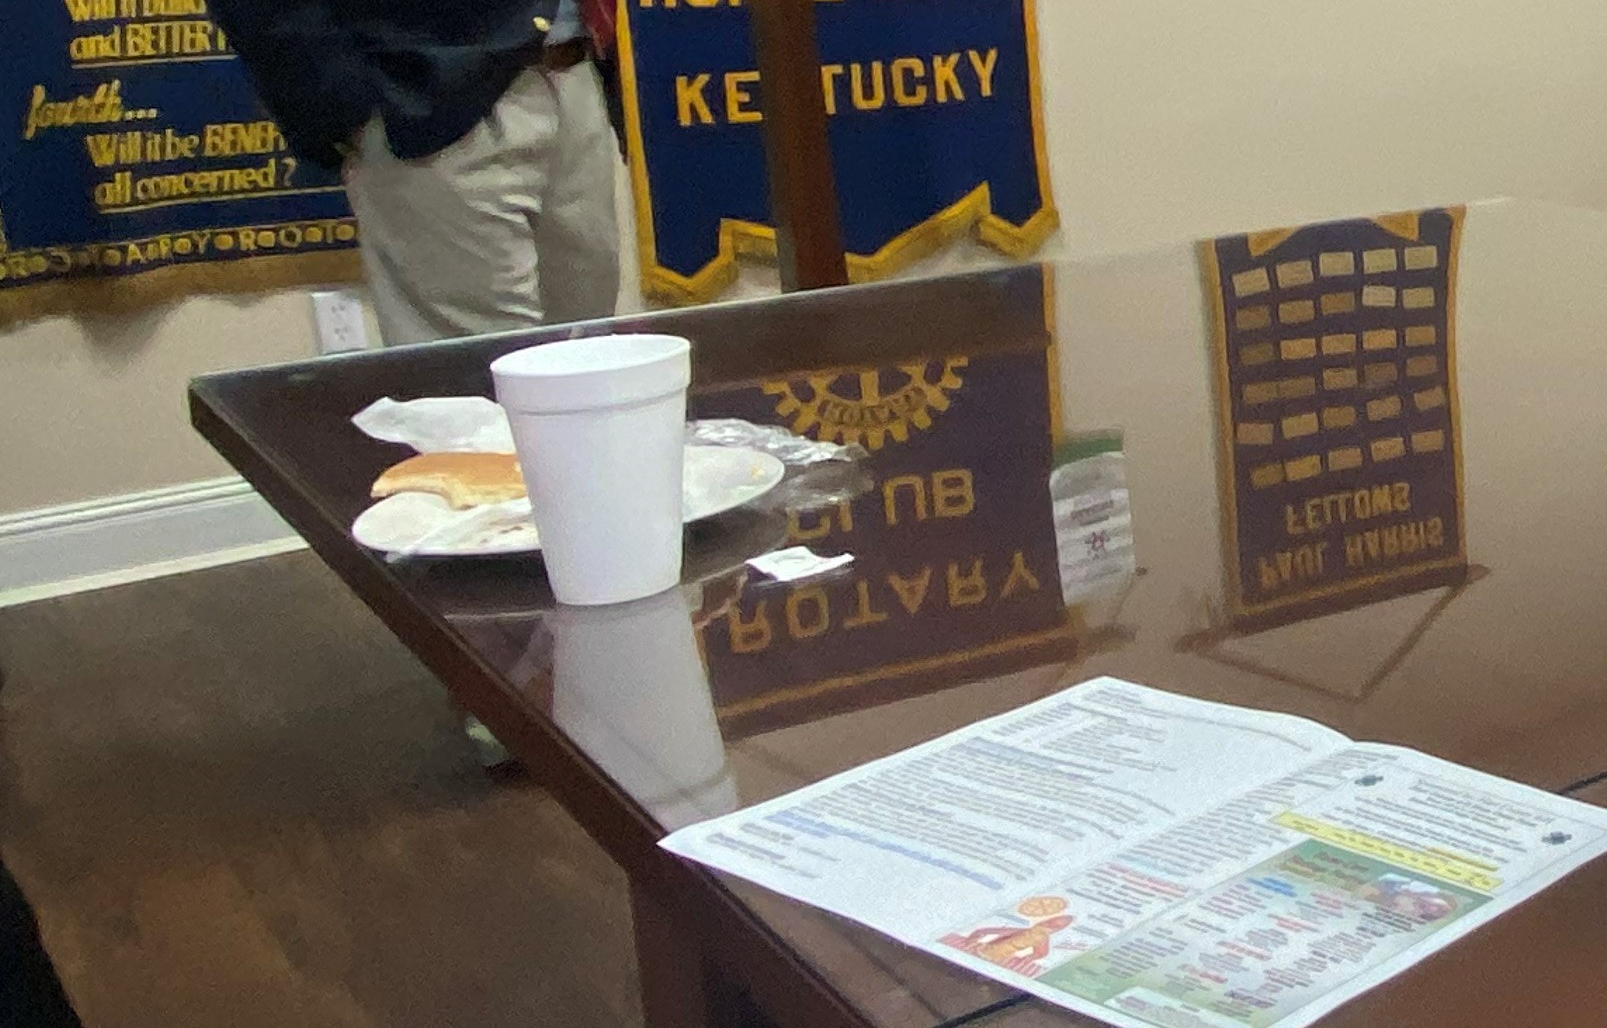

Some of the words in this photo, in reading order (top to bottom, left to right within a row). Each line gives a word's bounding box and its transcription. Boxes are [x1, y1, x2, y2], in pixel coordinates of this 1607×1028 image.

[69, 25, 120, 60] and
[125, 21, 213, 57] BETTER
[676, 48, 999, 127] KETUCKY
[86, 132, 141, 168] Will
[146, 132, 162, 164] it
[165, 128, 200, 161] be
[94, 171, 132, 206] all
